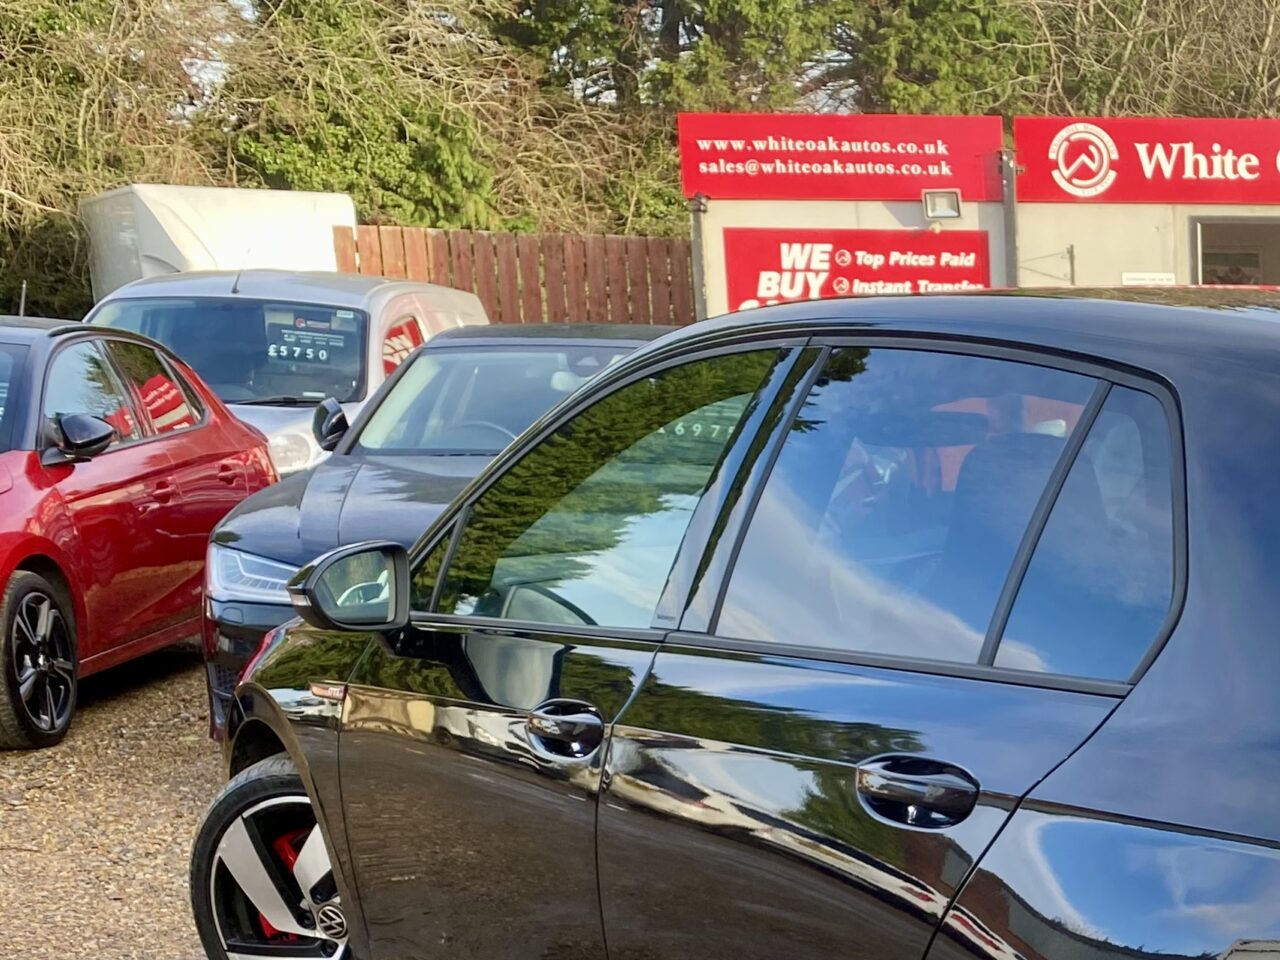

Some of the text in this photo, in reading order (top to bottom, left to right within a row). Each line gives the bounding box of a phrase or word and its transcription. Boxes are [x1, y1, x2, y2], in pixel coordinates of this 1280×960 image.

[696, 136, 949, 155] www.whiteoakautos.co.uk
[699, 158, 952, 175] sales@whiteoakautos.co.uk
[1133, 141, 1260, 180] White
[780, 243, 832, 270] WE
[855, 250, 976, 270] Top Prices Paid
[757, 271, 829, 299] BUY
[852, 279, 912, 294] Instant
[268, 344, 328, 361] £5750
